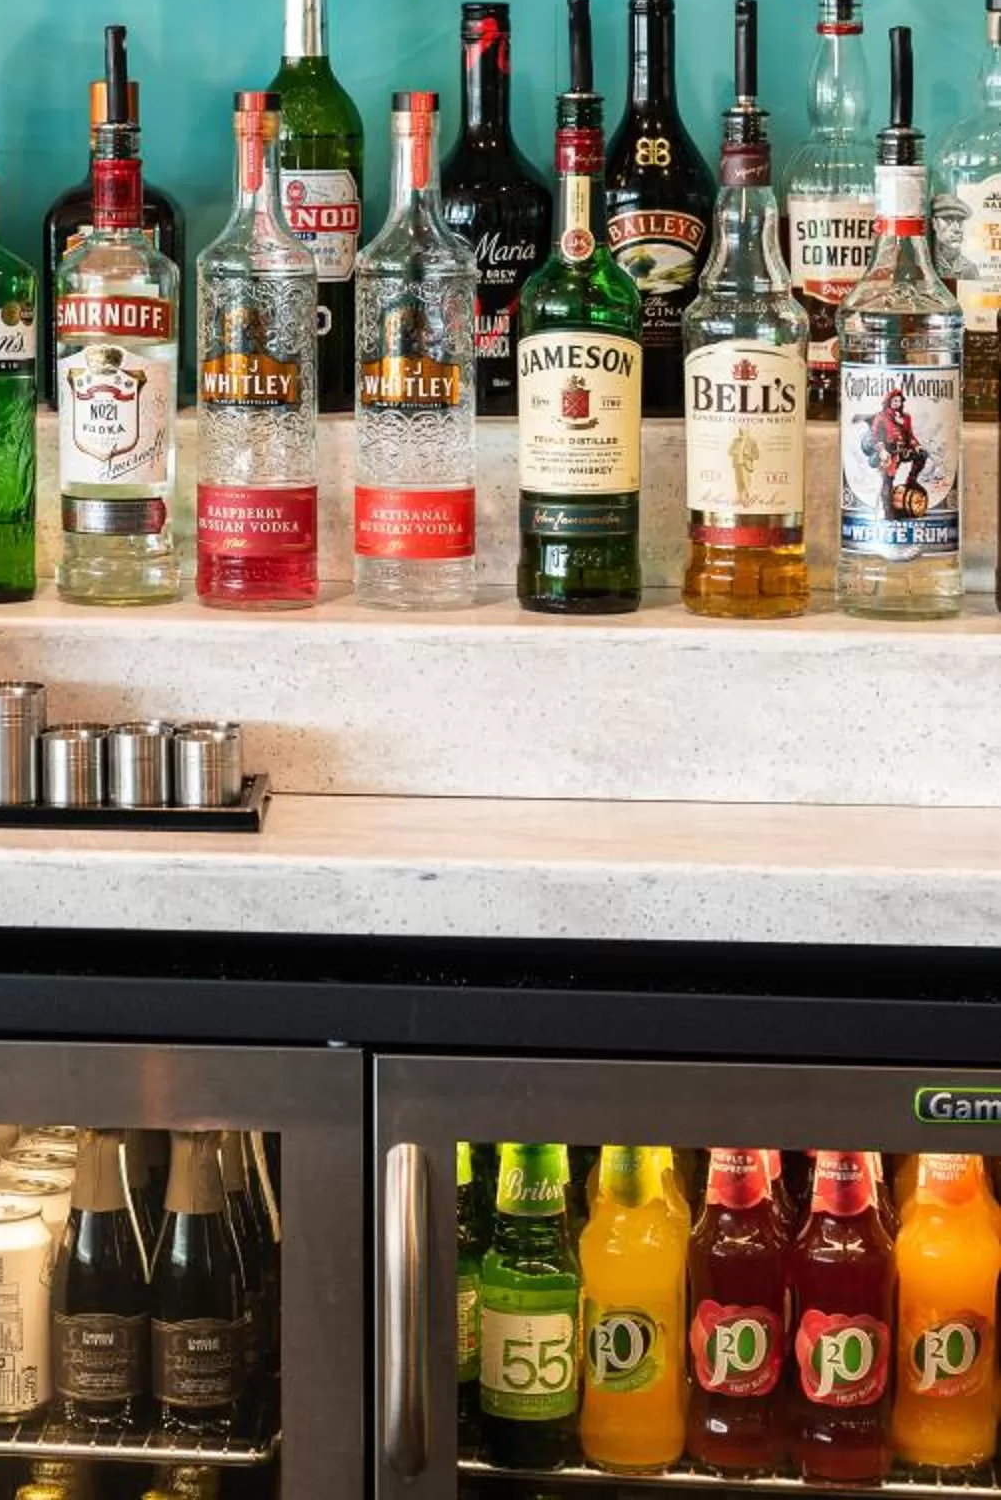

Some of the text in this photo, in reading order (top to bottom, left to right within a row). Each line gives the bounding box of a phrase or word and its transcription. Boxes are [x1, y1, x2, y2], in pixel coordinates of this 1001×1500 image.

[608, 215, 701, 243] BAILEYS
[475, 231, 536, 265] Maria
[486, 269, 517, 278] BREW
[521, 345, 635, 378] JAMESON
[204, 371, 293, 396] WHITLEY
[364, 374, 454, 398] WHITLEY
[897, 372, 955, 404] Morgan
[568, 466, 614, 476] WHISKEY
[207, 505, 284, 519] RASPBERRY
[250, 520, 300, 533] VODKA
[852, 524, 949, 544] WHITE RUM
[929, 1091, 1001, 1120] Gam
[503, 1339, 568, 1390] 55
